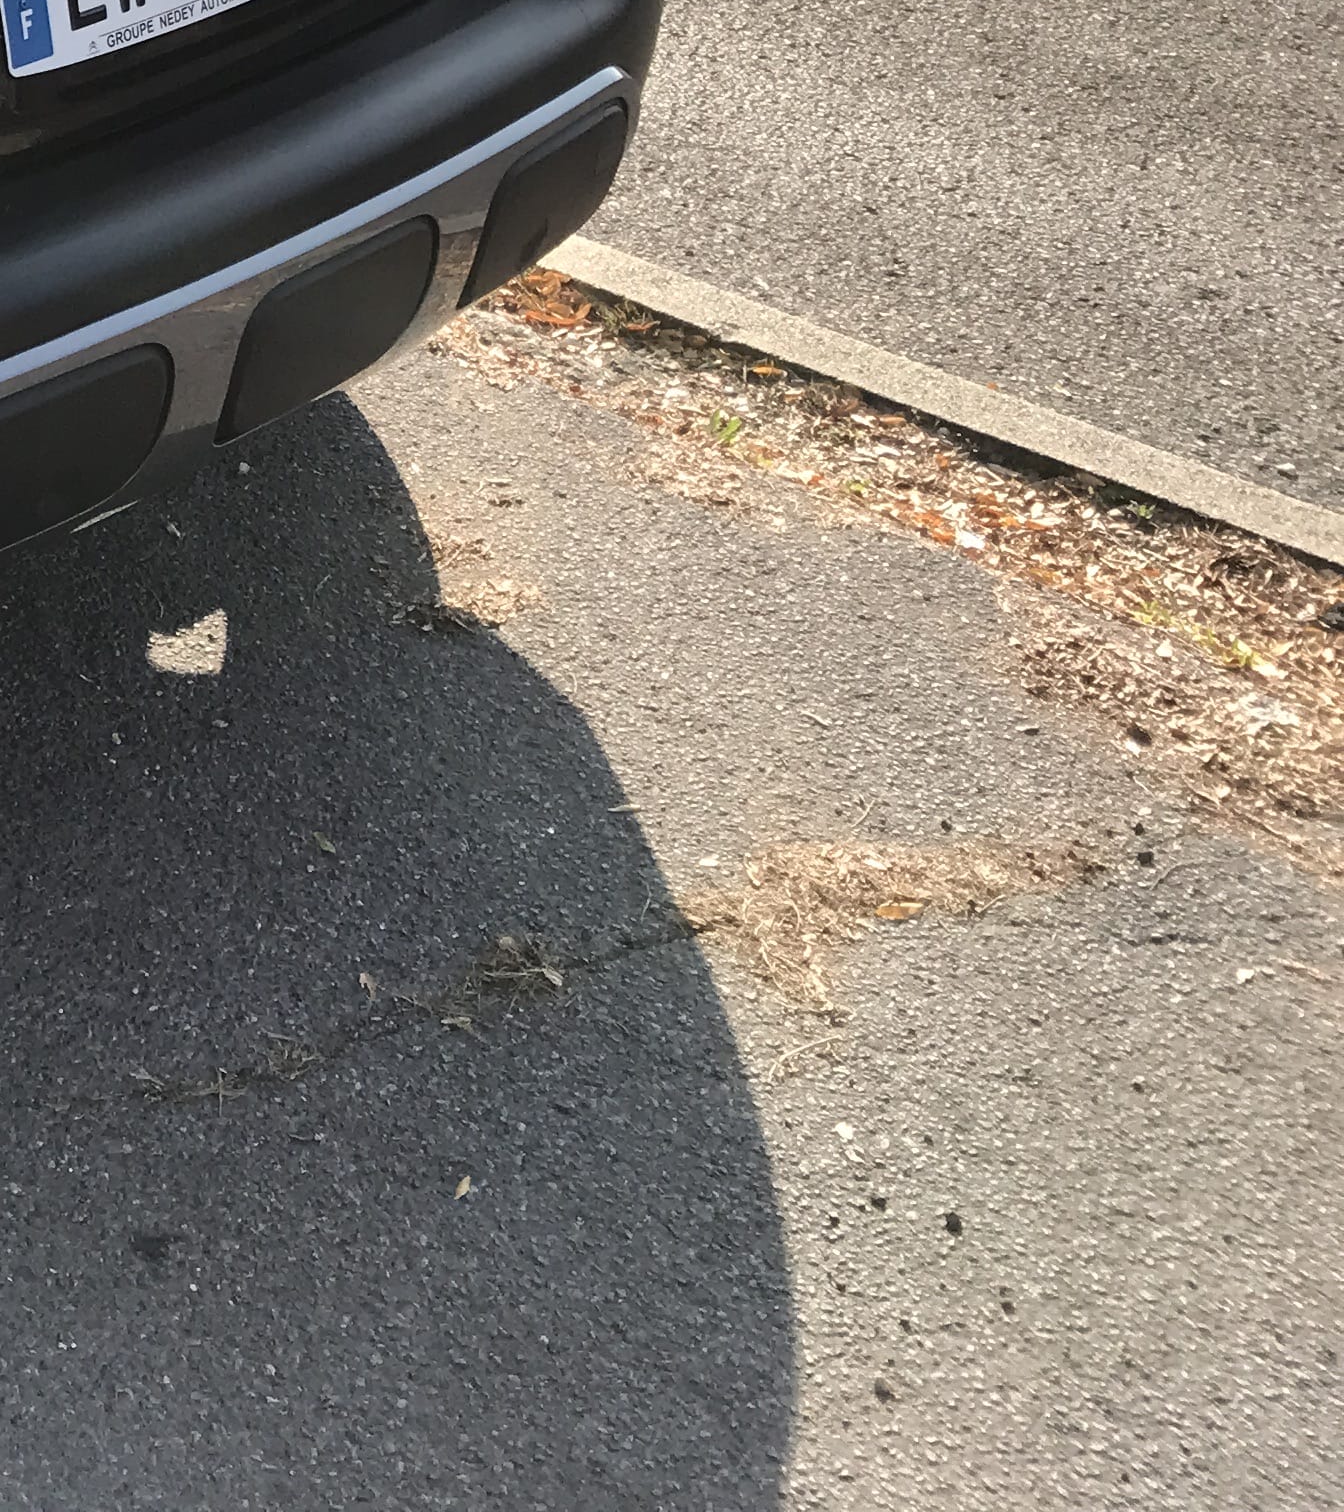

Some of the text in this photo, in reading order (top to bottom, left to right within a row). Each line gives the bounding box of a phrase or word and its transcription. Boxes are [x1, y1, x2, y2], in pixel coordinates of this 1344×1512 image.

[18, 9, 34, 41] F
[106, 19, 154, 48] GROUPE
[159, 4, 194, 29] NEDEY
